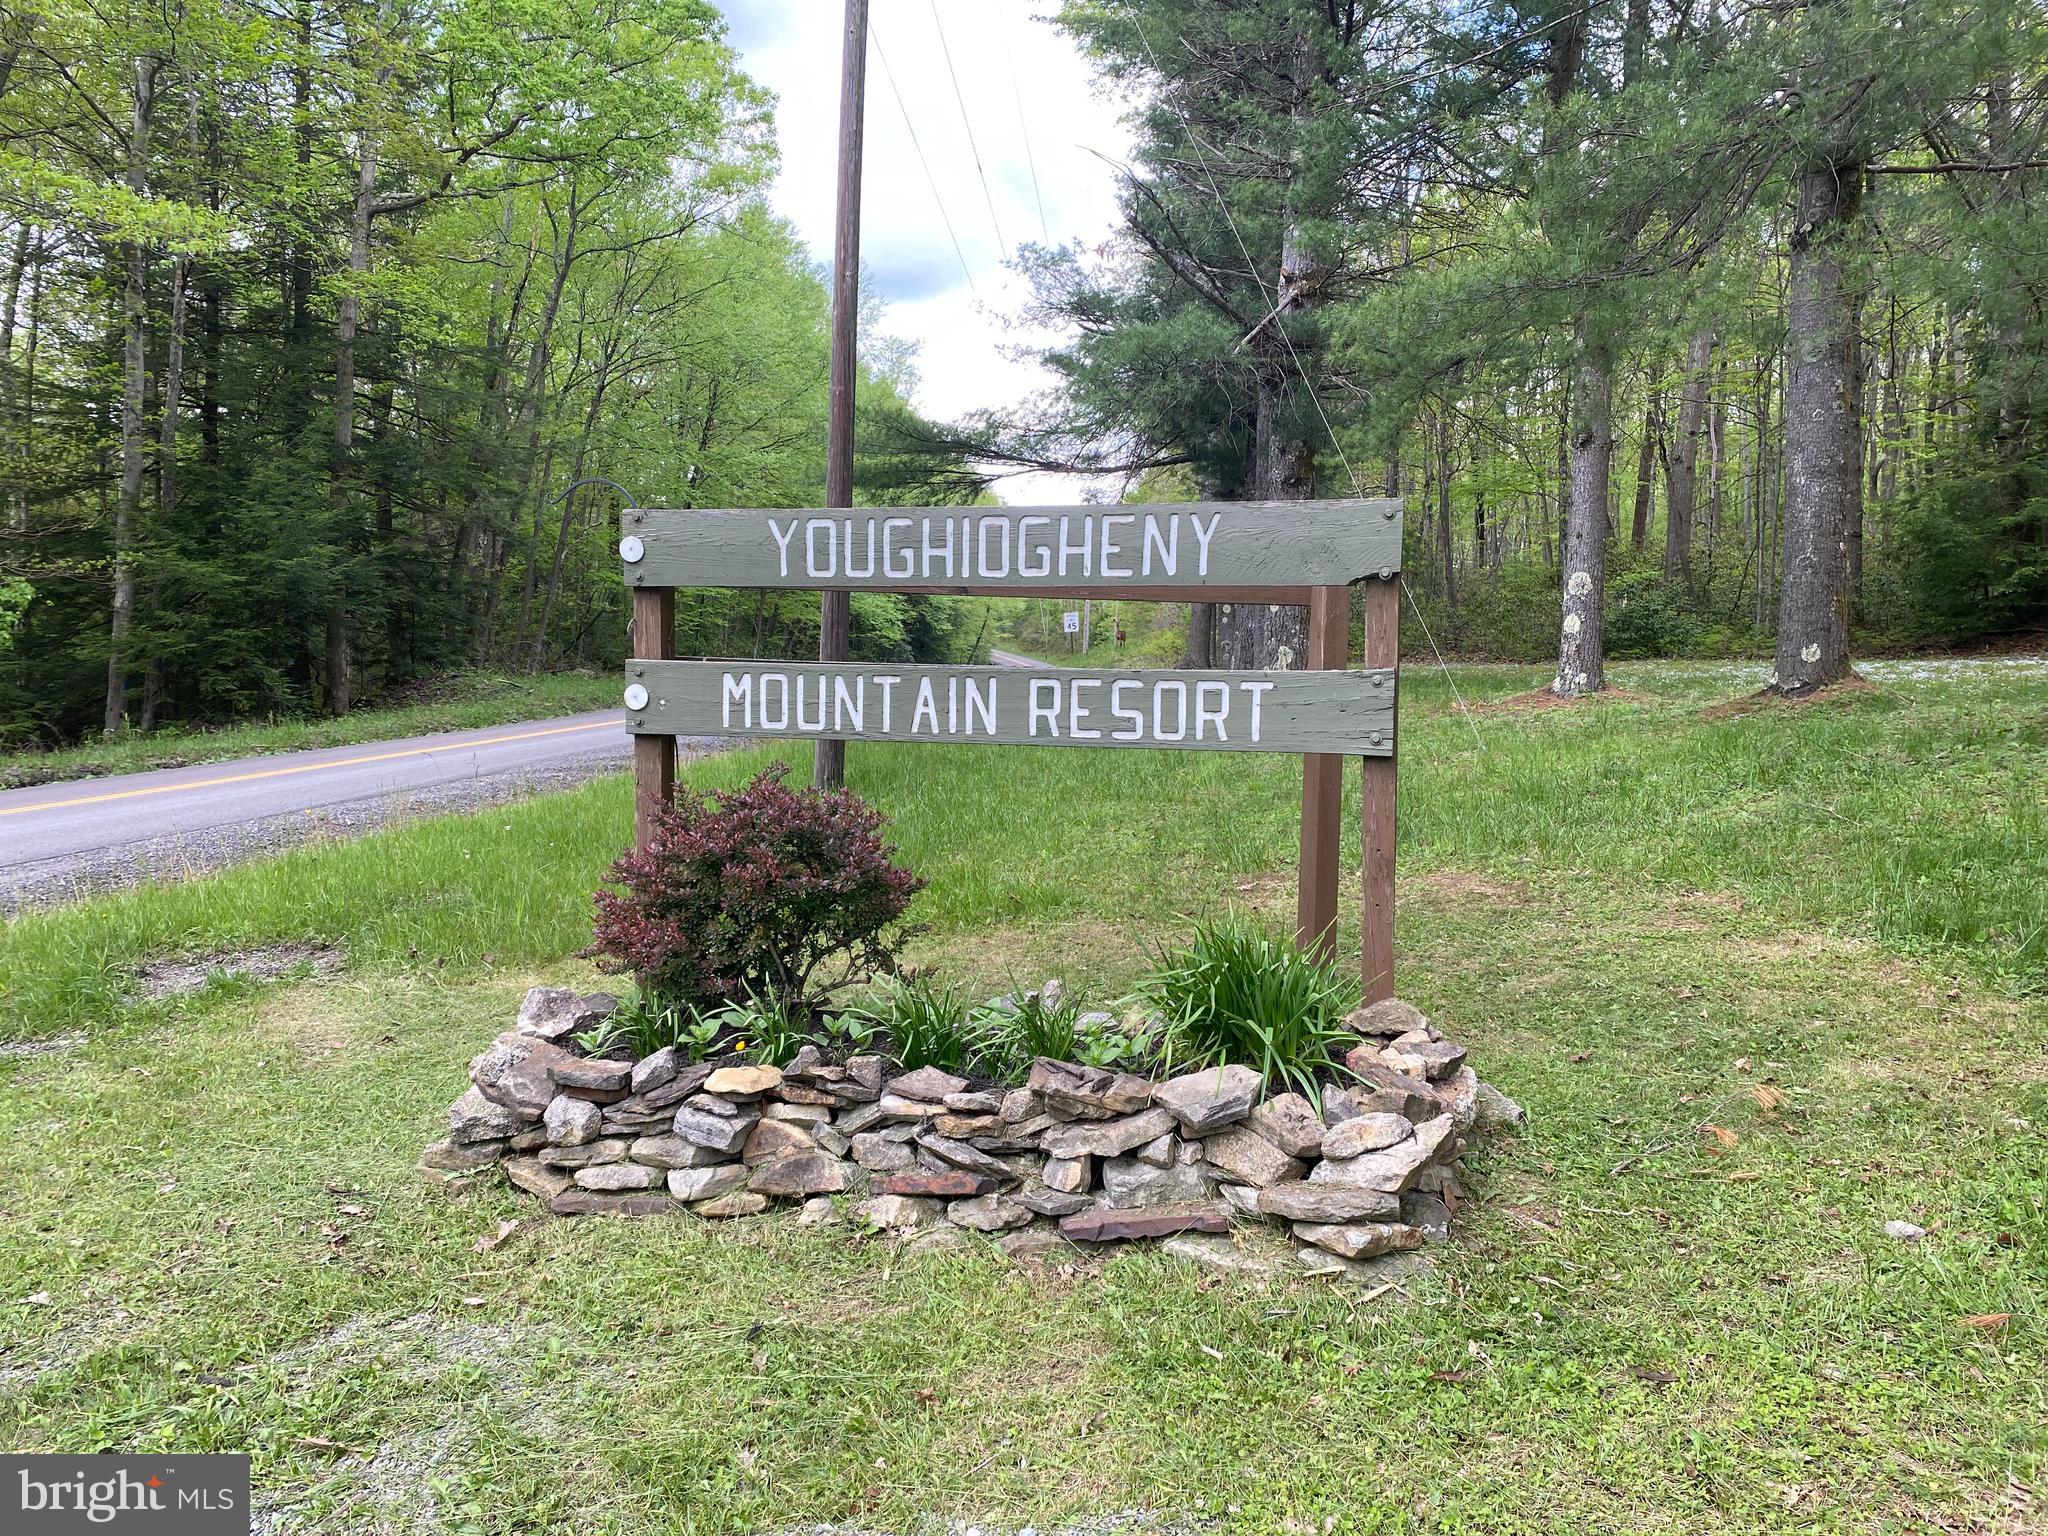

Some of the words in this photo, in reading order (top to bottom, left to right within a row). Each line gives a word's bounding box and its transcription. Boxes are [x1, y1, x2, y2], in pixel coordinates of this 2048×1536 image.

[767, 512, 1222, 579] YOUGHIOGHENY
[1067, 622, 1077, 630] 45
[721, 672, 998, 737] MOUNTAIN
[1028, 677, 1275, 743] RESORT
